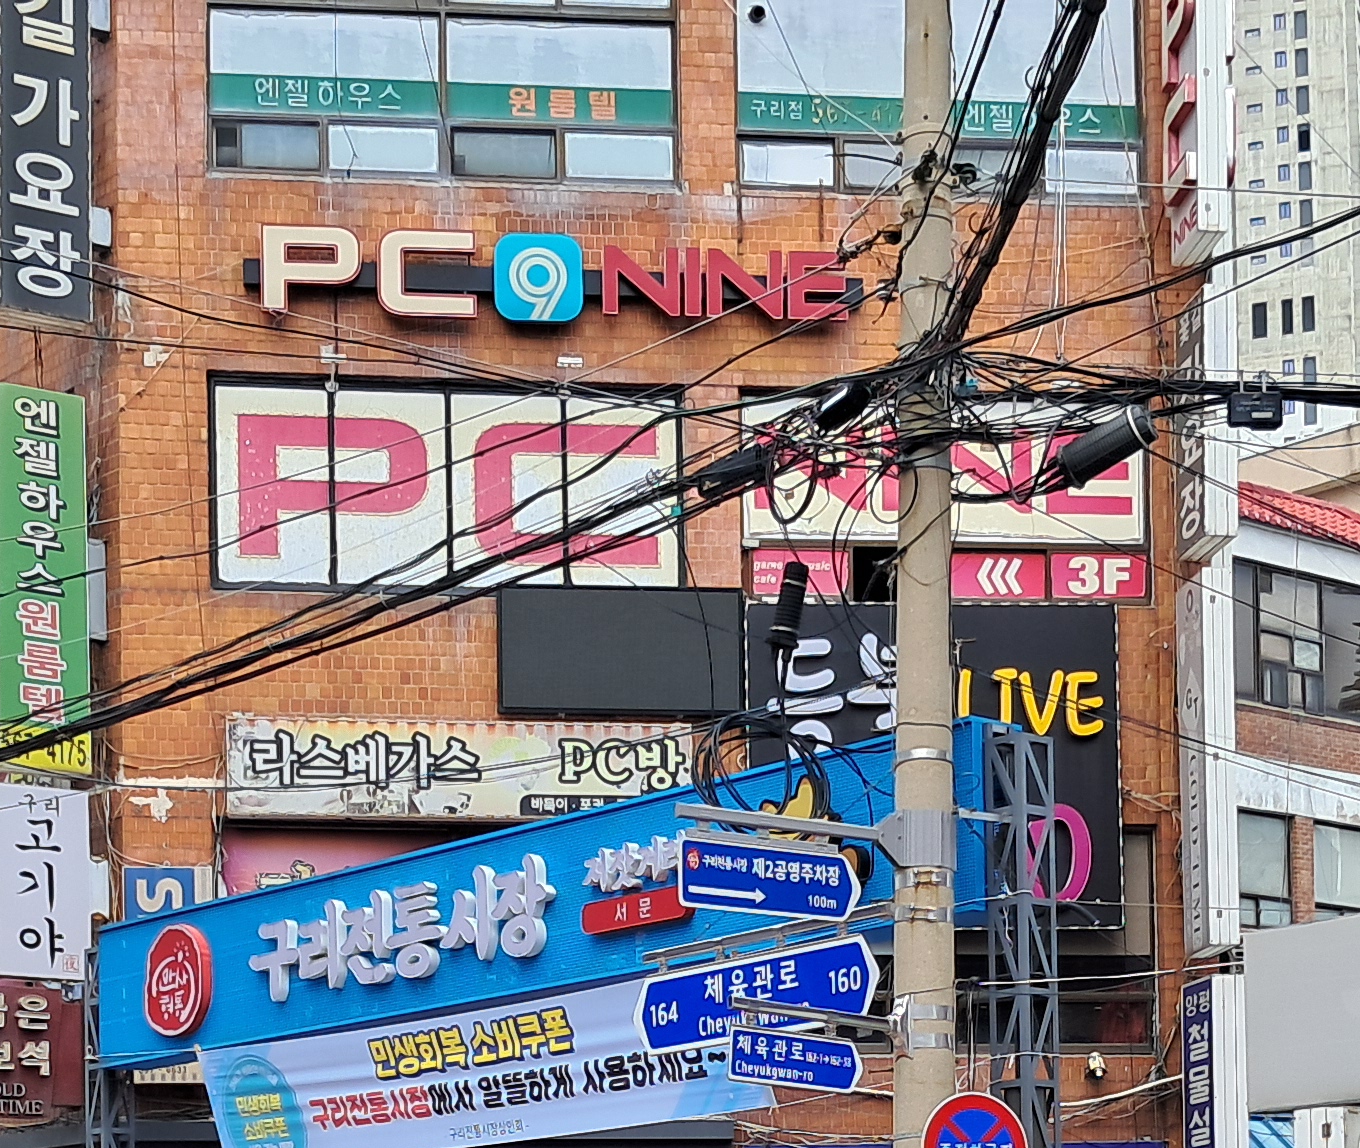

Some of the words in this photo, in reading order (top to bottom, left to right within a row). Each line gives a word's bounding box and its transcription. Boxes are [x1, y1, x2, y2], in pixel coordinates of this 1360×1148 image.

[751, 99, 803, 121] 구리점
[260, 223, 478, 318] PC
[602, 244, 849, 320] NINE
[13, 396, 65, 597] 엔젤하우스
[1067, 556, 1130, 597] 3F
[250, 729, 482, 786] 라스베가스
[559, 738, 686, 790] PC방
[18, 793, 60, 816] 구리
[751, 857, 840, 887] 제2공영주차장
[15, 818, 64, 968] 고기야
[807, 894, 837, 909] 100m
[249, 851, 556, 1002] 구리전통시장
[704, 959, 799, 1004] 체육관로
[828, 965, 862, 994] 160
[649, 1000, 679, 1028] 164
[1185, 987, 1210, 1014] 양평
[367, 1027, 468, 1081] 민생회복
[473, 1005, 575, 1064] 소비쿠폰
[736, 1033, 805, 1061] 체육관로
[735, 1062, 814, 1082] Cheyukgwan-ro
[308, 1083, 477, 1132] 구리전통시장에서
[478, 1067, 577, 1110] 알뜰하게
